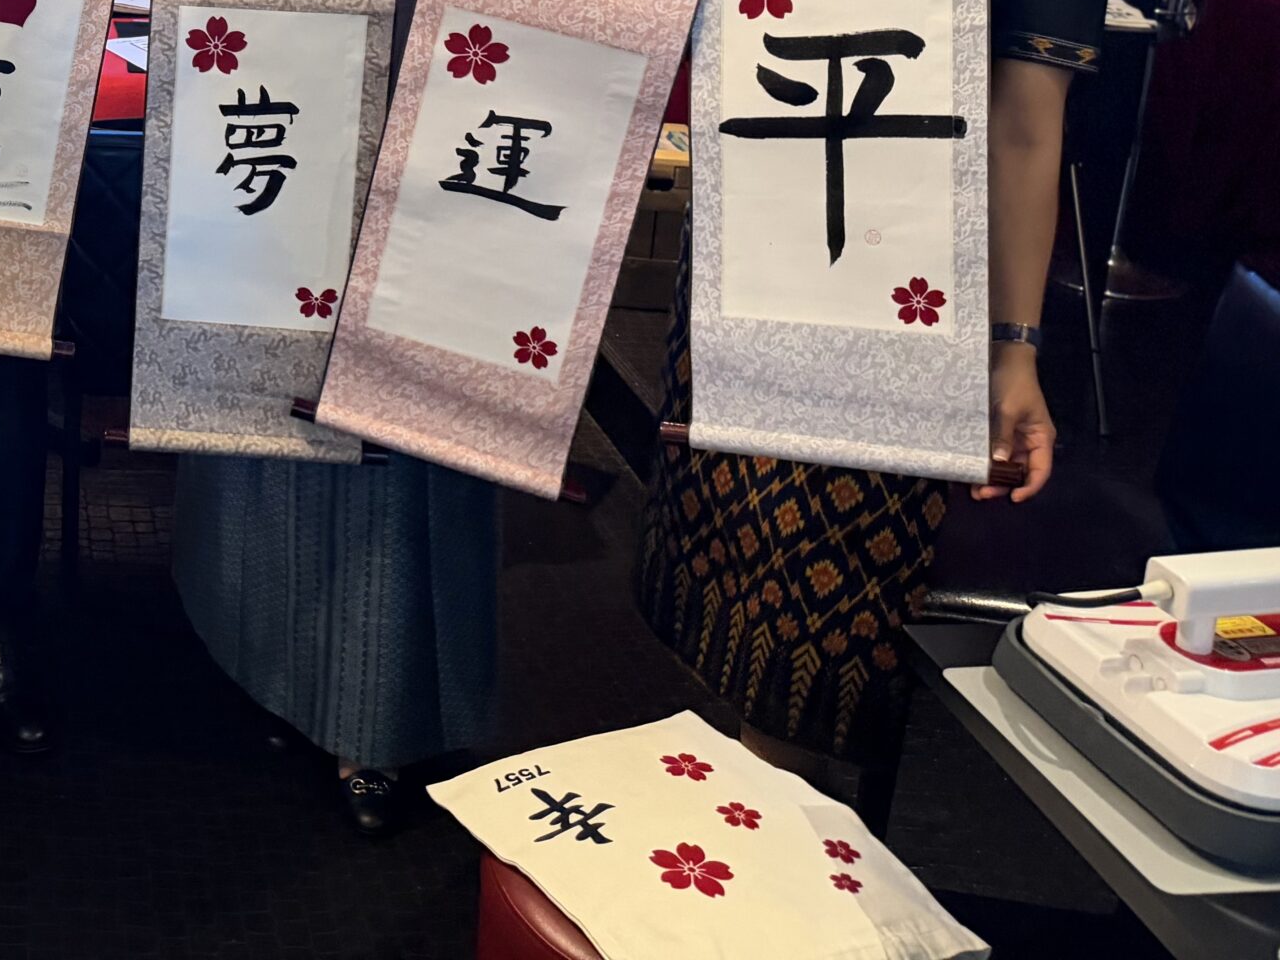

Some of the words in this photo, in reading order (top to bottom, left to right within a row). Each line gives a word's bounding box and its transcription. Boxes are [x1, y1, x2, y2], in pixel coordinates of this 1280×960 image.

[216, 84, 300, 216] 夢
[438, 109, 568, 222] 運
[718, 27, 967, 268] 平
[494, 763, 551, 793] 7557
[528, 787, 616, 845] 幸
